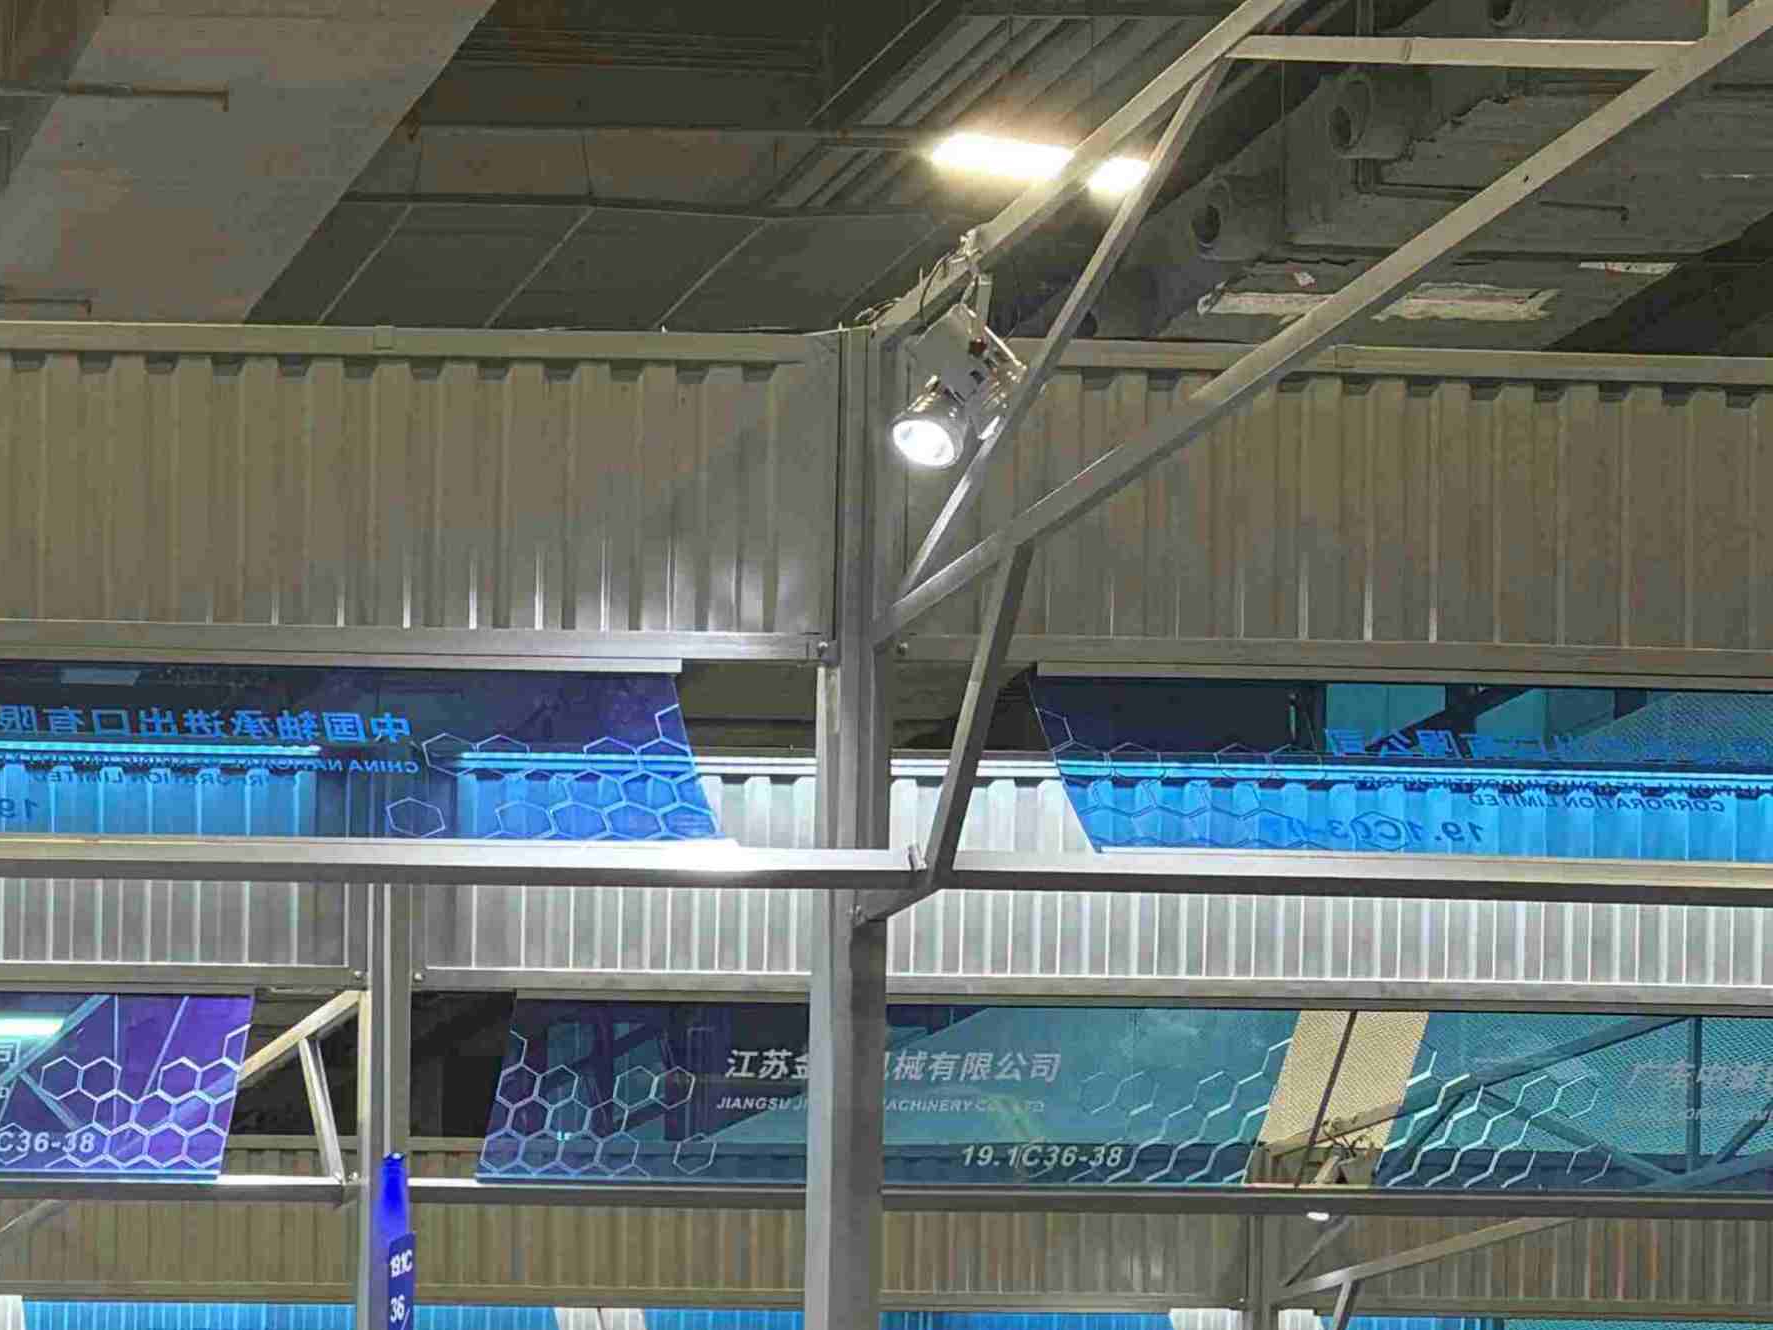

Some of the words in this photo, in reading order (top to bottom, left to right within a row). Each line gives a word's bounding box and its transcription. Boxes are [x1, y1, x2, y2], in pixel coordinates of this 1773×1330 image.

[716, 1095, 791, 1111] JIANGSU
[961, 1143, 1123, 1170] 19.1C36-38
[389, 1294, 406, 1324] 36
